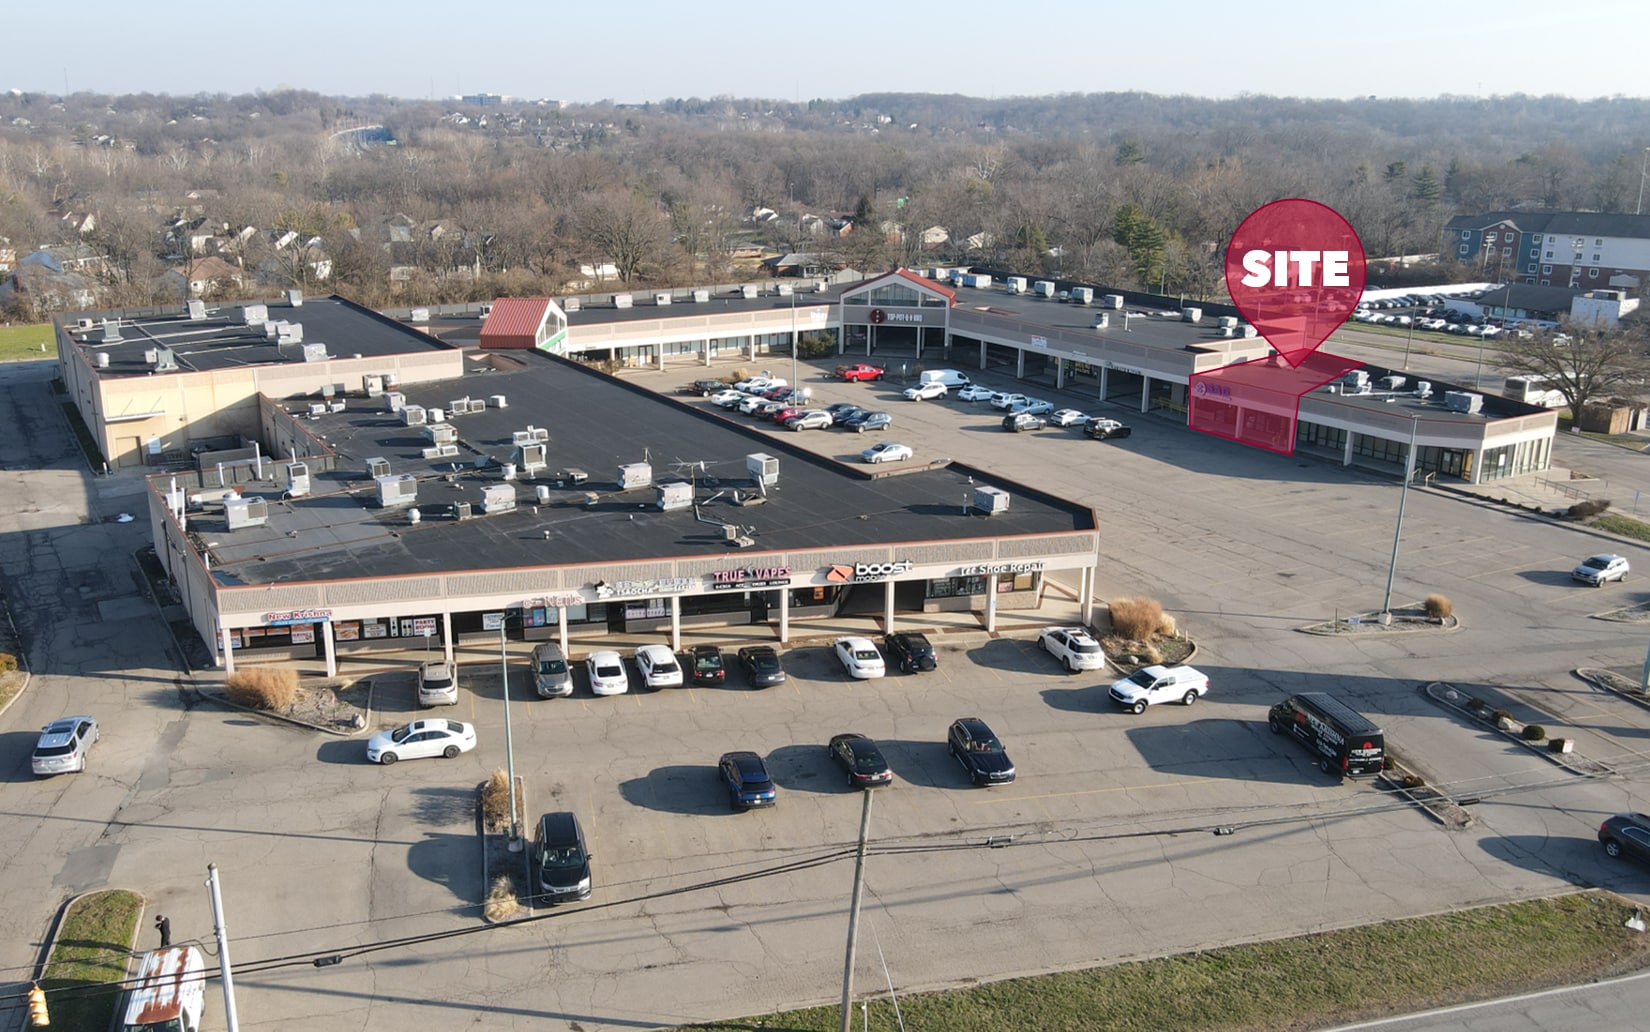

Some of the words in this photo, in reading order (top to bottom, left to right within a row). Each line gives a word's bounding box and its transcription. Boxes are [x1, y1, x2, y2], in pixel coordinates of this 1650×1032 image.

[713, 570, 746, 583] TRUE
[755, 566, 793, 580] VAPES
[856, 560, 913, 576] boost
[979, 564, 1007, 575] Shoe
[1010, 561, 1046, 573] Repair
[543, 594, 585, 608] Nails
[267, 612, 292, 621] New
[292, 609, 334, 619] Krishna
